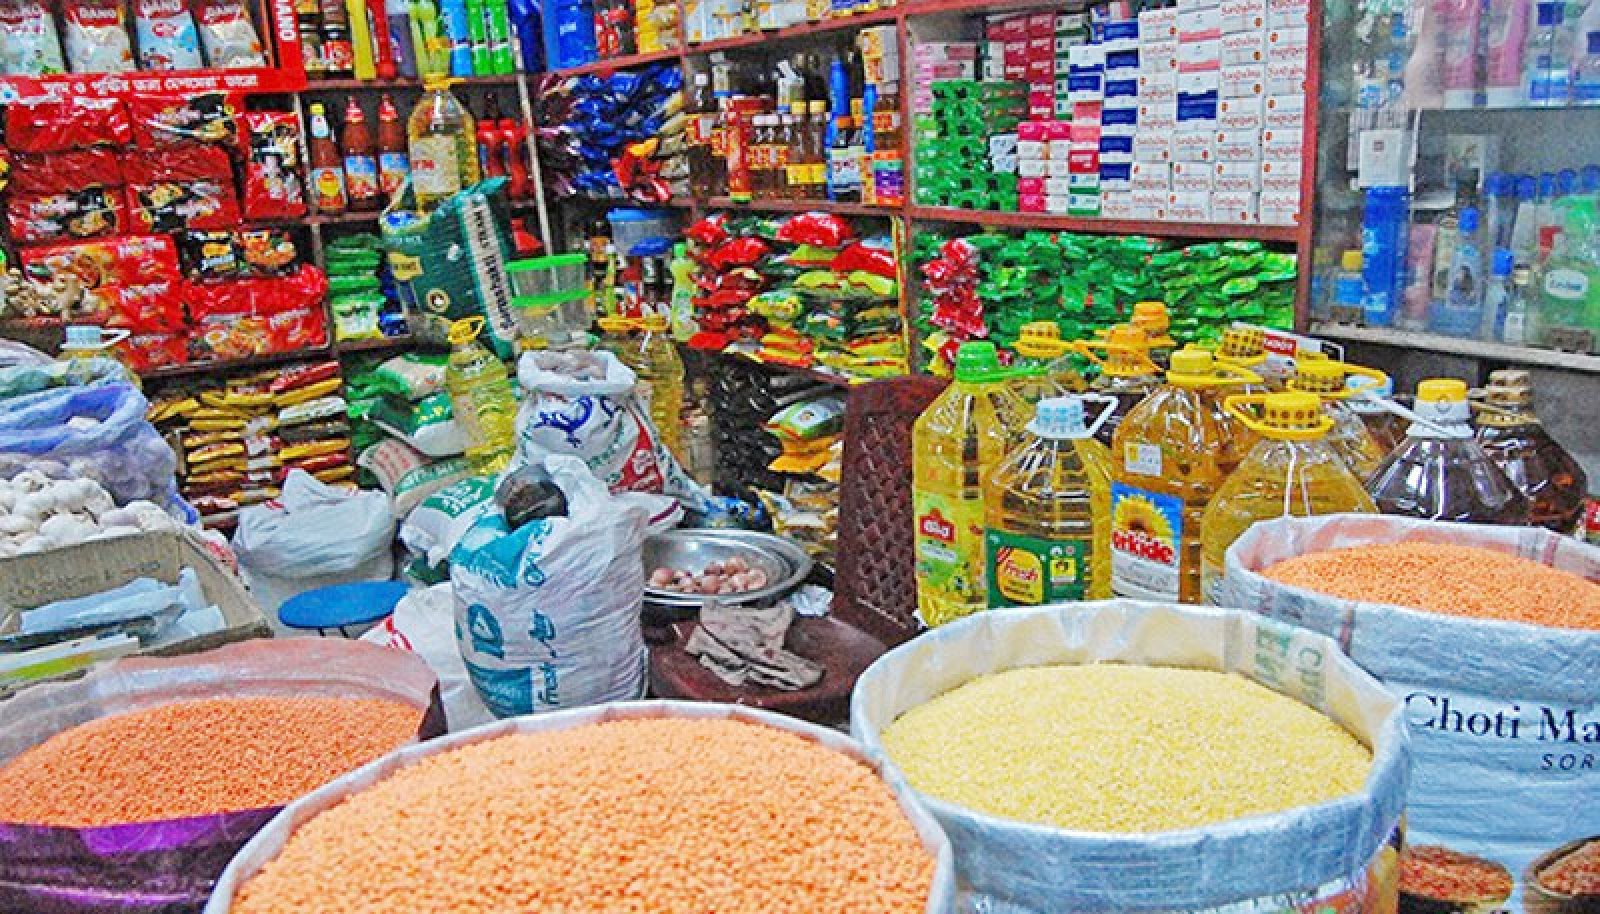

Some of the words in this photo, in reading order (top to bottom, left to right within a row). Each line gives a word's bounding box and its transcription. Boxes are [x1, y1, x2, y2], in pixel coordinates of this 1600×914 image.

[1404, 691, 1521, 738] Choti
[1536, 706, 1600, 742] Ma
[1541, 753, 1595, 770] SOR
